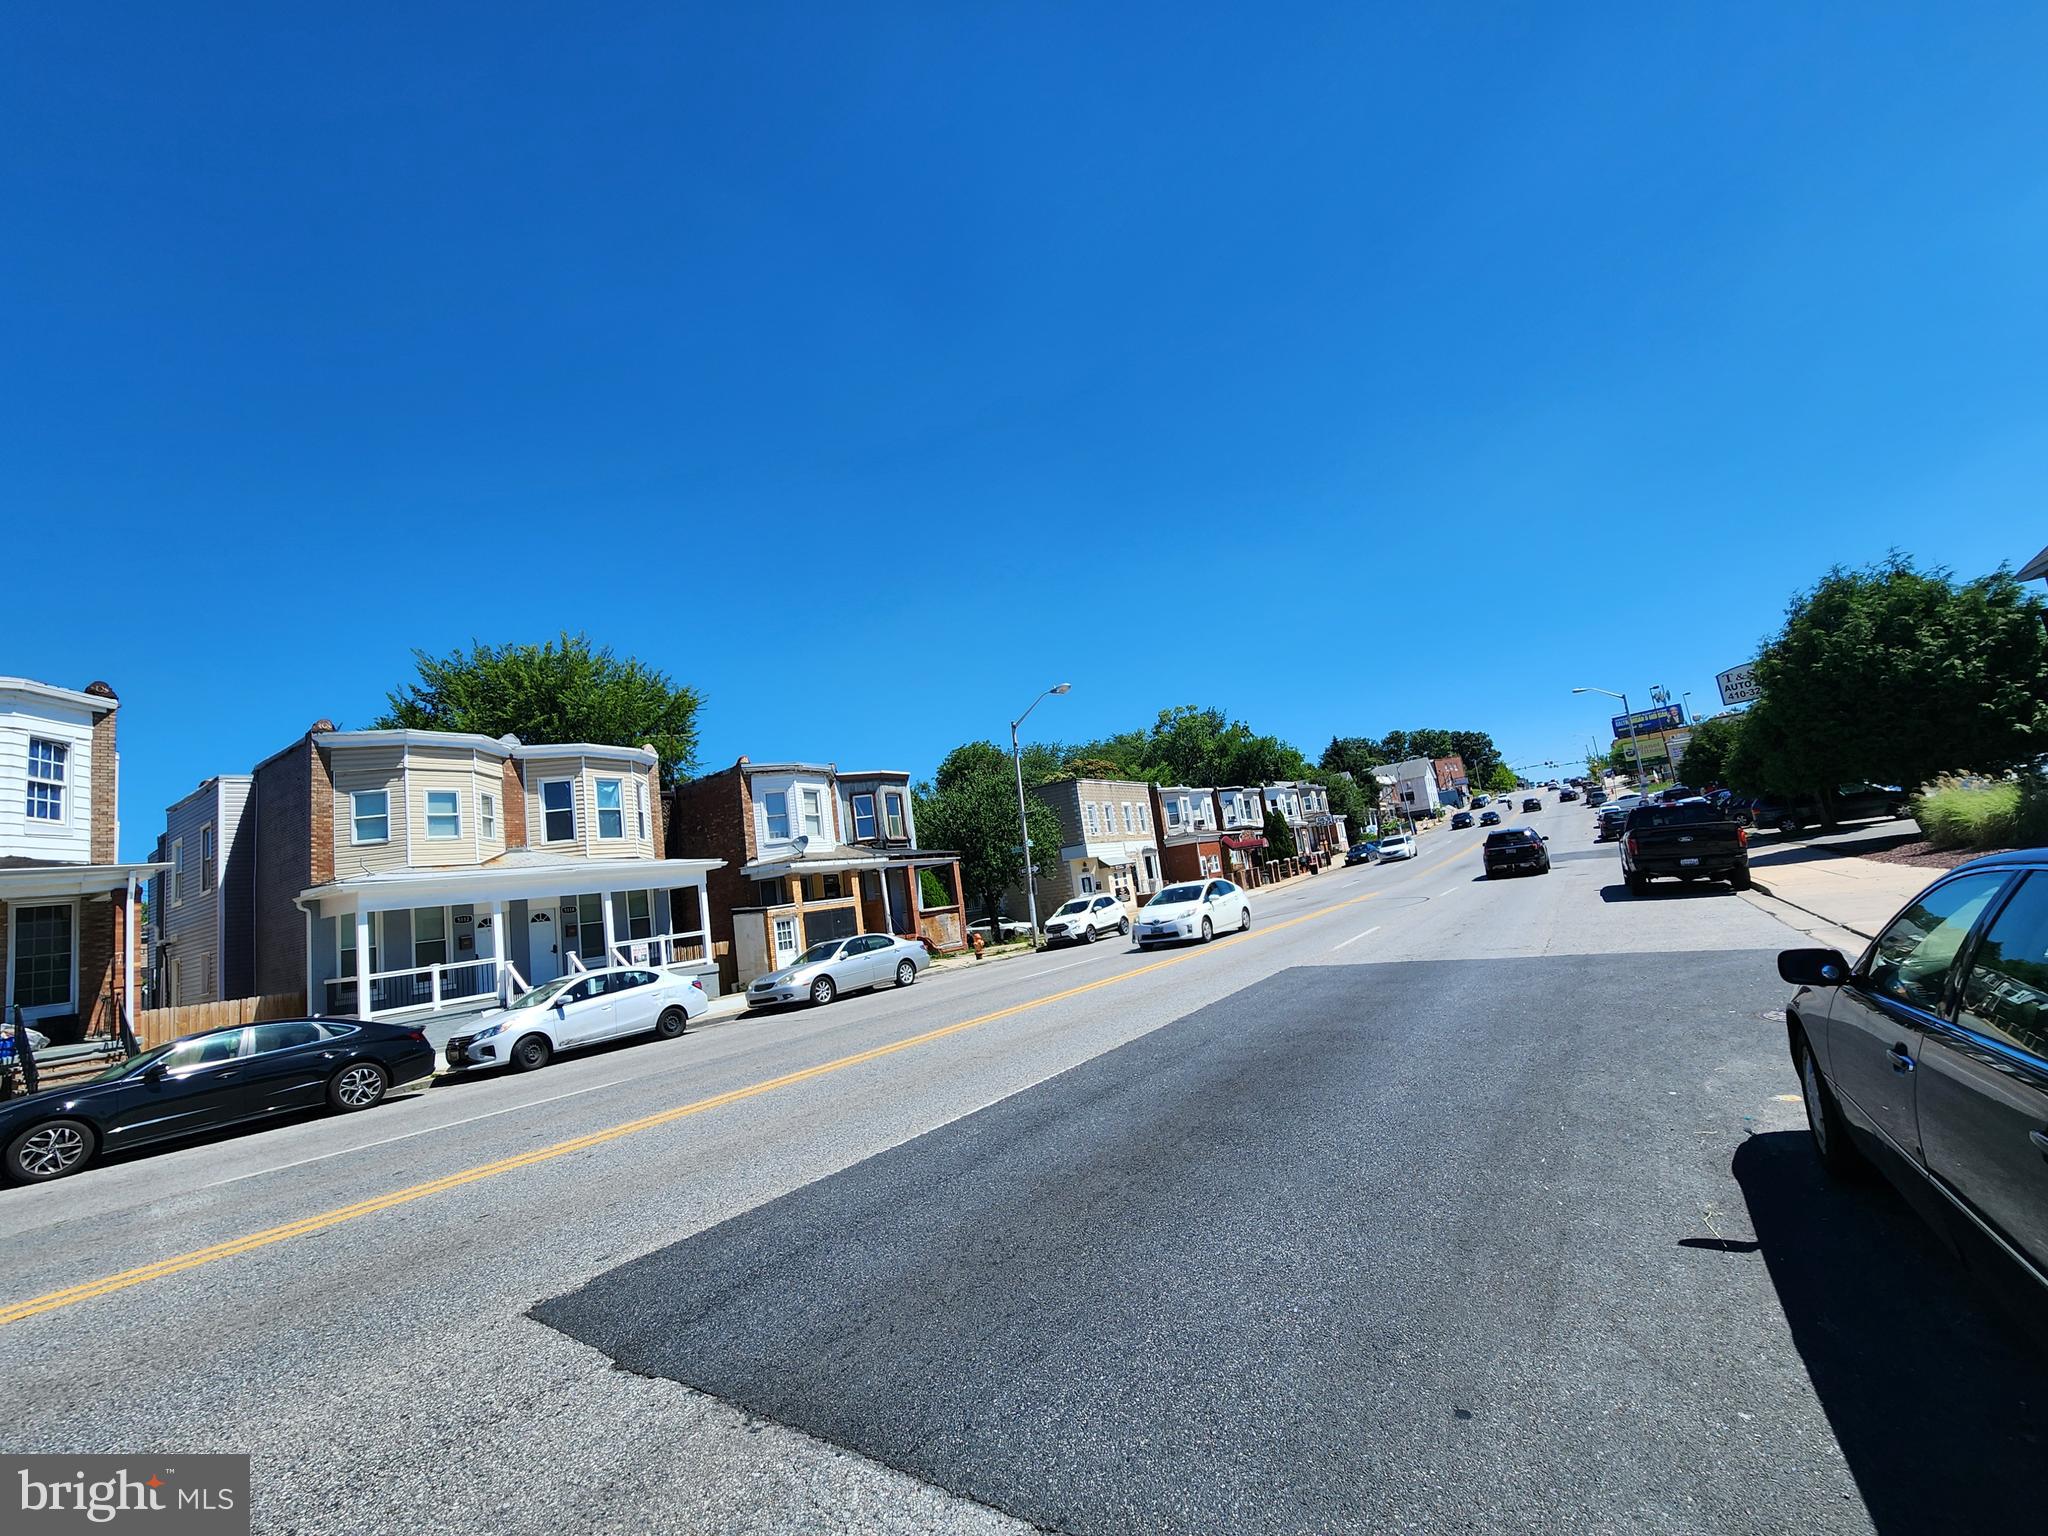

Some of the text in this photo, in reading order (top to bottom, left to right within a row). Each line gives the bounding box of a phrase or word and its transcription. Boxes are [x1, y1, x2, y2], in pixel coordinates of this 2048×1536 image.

[1721, 672, 1734, 683] T
[1735, 672, 1744, 681] &
[1724, 680, 1752, 693] AUTO
[1728, 687, 1761, 700] 410-32
